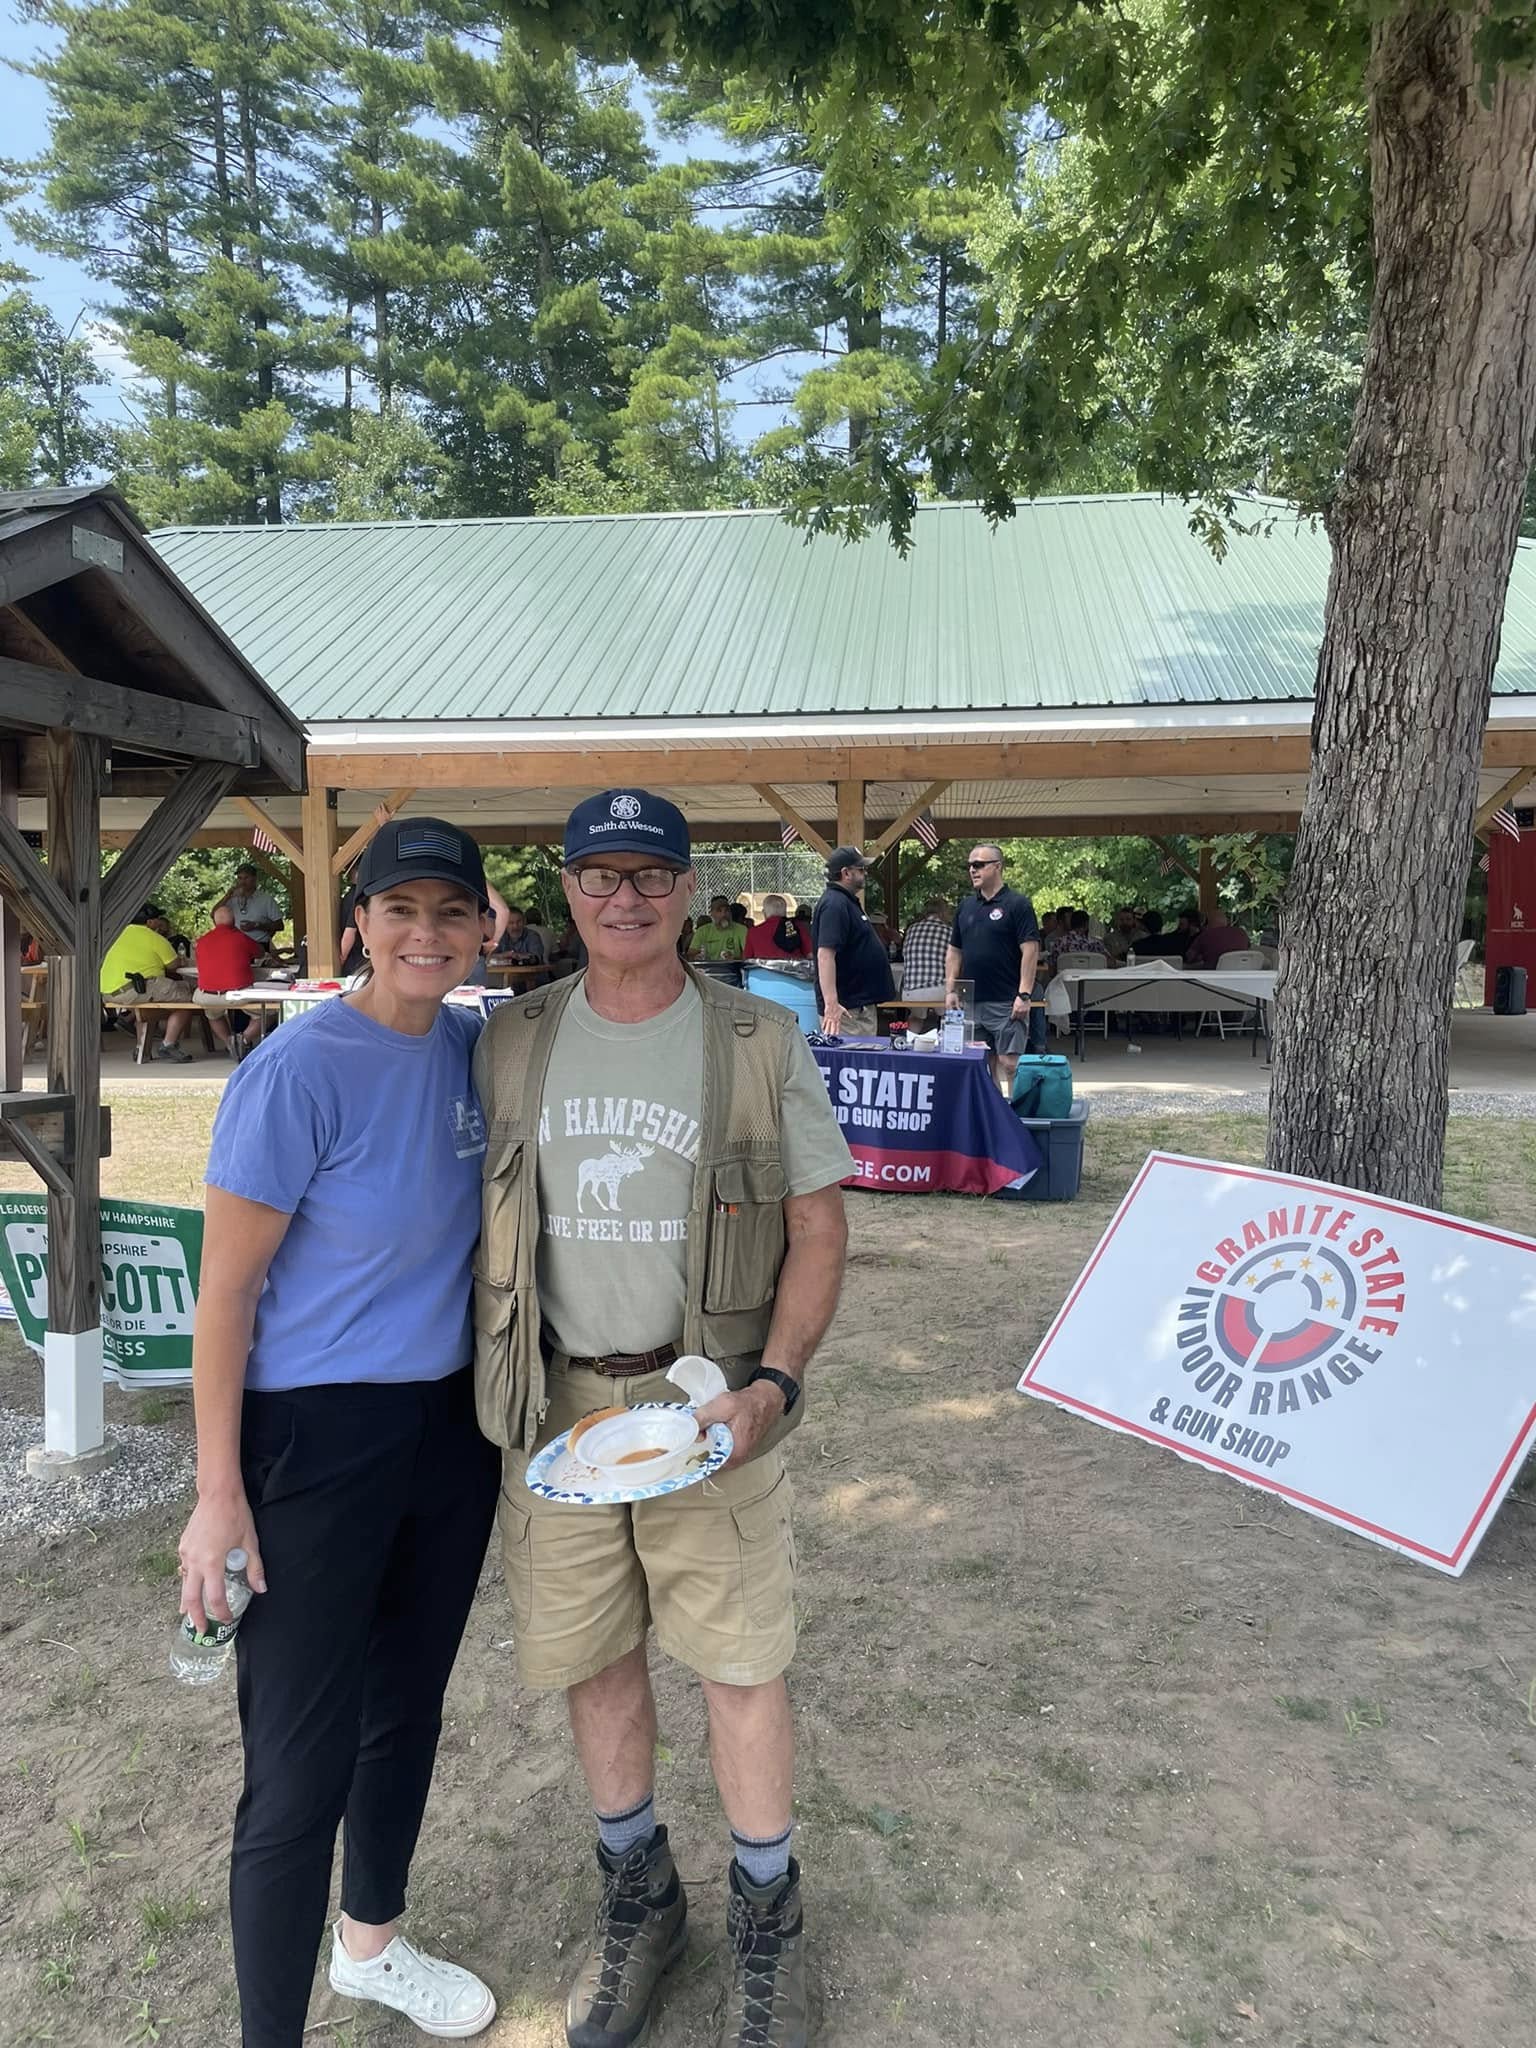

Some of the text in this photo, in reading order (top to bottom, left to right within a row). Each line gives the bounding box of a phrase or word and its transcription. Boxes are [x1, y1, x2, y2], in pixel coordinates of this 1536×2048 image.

[838, 1066, 936, 1111] STATE
[563, 1097, 700, 1163] HAMPSHI
[851, 1106, 884, 1129] GUN
[886, 1110, 932, 1132] SHOP
[851, 1158, 932, 1183] GE.COM
[0, 1204, 48, 1216] LEADERS
[113, 1211, 177, 1229] HAMPSHIRE
[576, 1217, 624, 1243] FREE
[628, 1219, 654, 1243] OR
[659, 1218, 689, 1242] DIE
[101, 1242, 149, 1257] PSHIRE
[1196, 1204, 1406, 1337] GRANITE STATE
[124, 1319, 146, 1331] DIE
[104, 1334, 146, 1356] GRESS
[1176, 1286, 1383, 1416] INDOOR RANGE
[1149, 1396, 1292, 1468] & GUN SHOP
